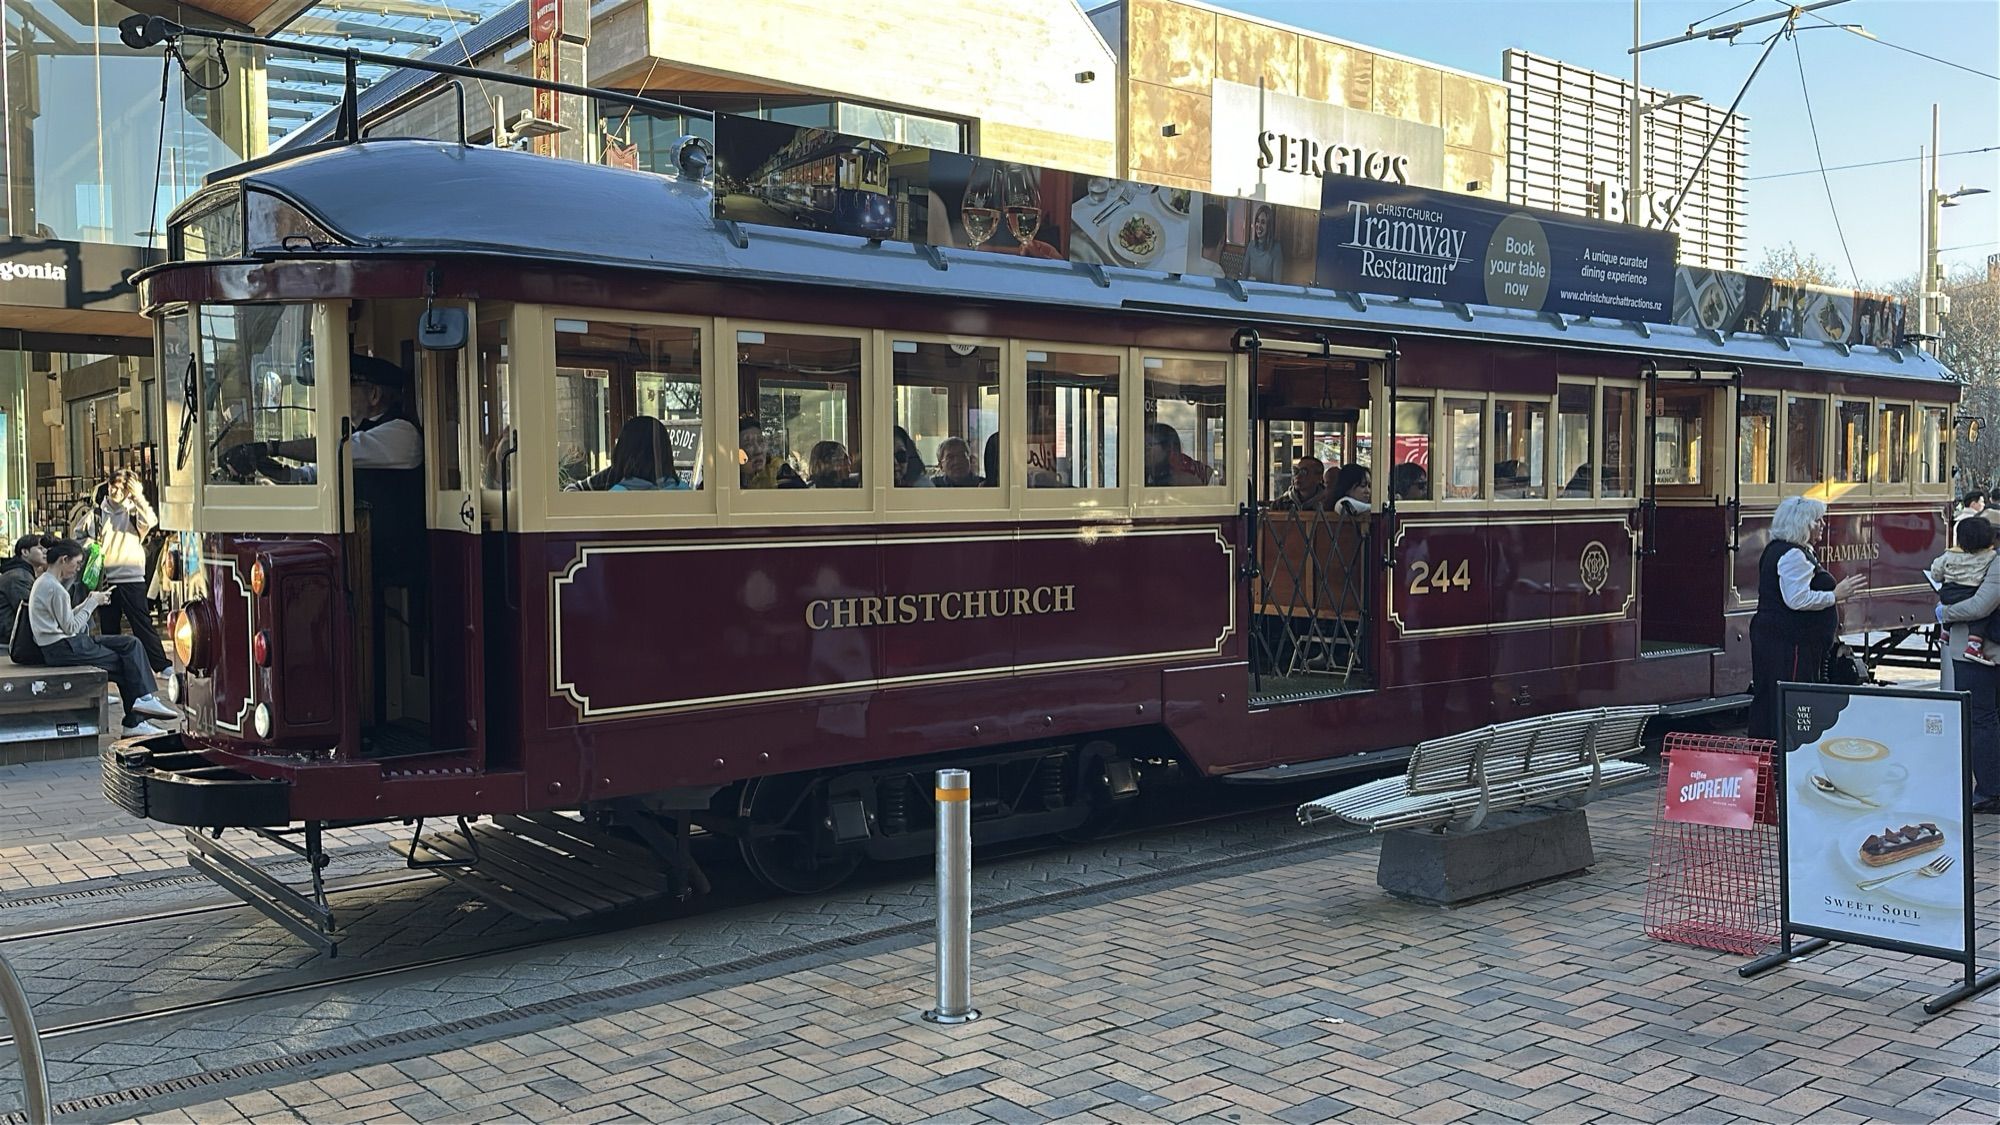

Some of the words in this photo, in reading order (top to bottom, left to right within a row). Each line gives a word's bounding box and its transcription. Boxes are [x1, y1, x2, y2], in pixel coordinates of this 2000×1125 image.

[1376, 203, 1443, 223] CHRISTCHURCH
[1347, 200, 1467, 271] Tramway
[1505, 236, 1536, 257] Book
[1360, 249, 1448, 285] Restaurant
[1489, 259, 1516, 276] your
[1518, 260, 1546, 279] table
[1583, 248, 1591, 260] A
[1591, 250, 1618, 265] unique
[1619, 254, 1648, 269] curated
[0, 260, 66, 281] gonia
[1581, 265, 1606, 282] dining
[1606, 270, 1648, 285] experience
[1504, 281, 1529, 297] now
[1560, 289, 1663, 311] www.christchurchattractions.nz
[667, 428, 697, 450] RSIDE
[1818, 543, 1880, 563] TRAMWAYS
[1409, 559, 1471, 595] 244
[805, 584, 1076, 630] CHRISTCHURCH
[1797, 705, 1811, 713] ART
[1679, 776, 1743, 803] SUPREME
